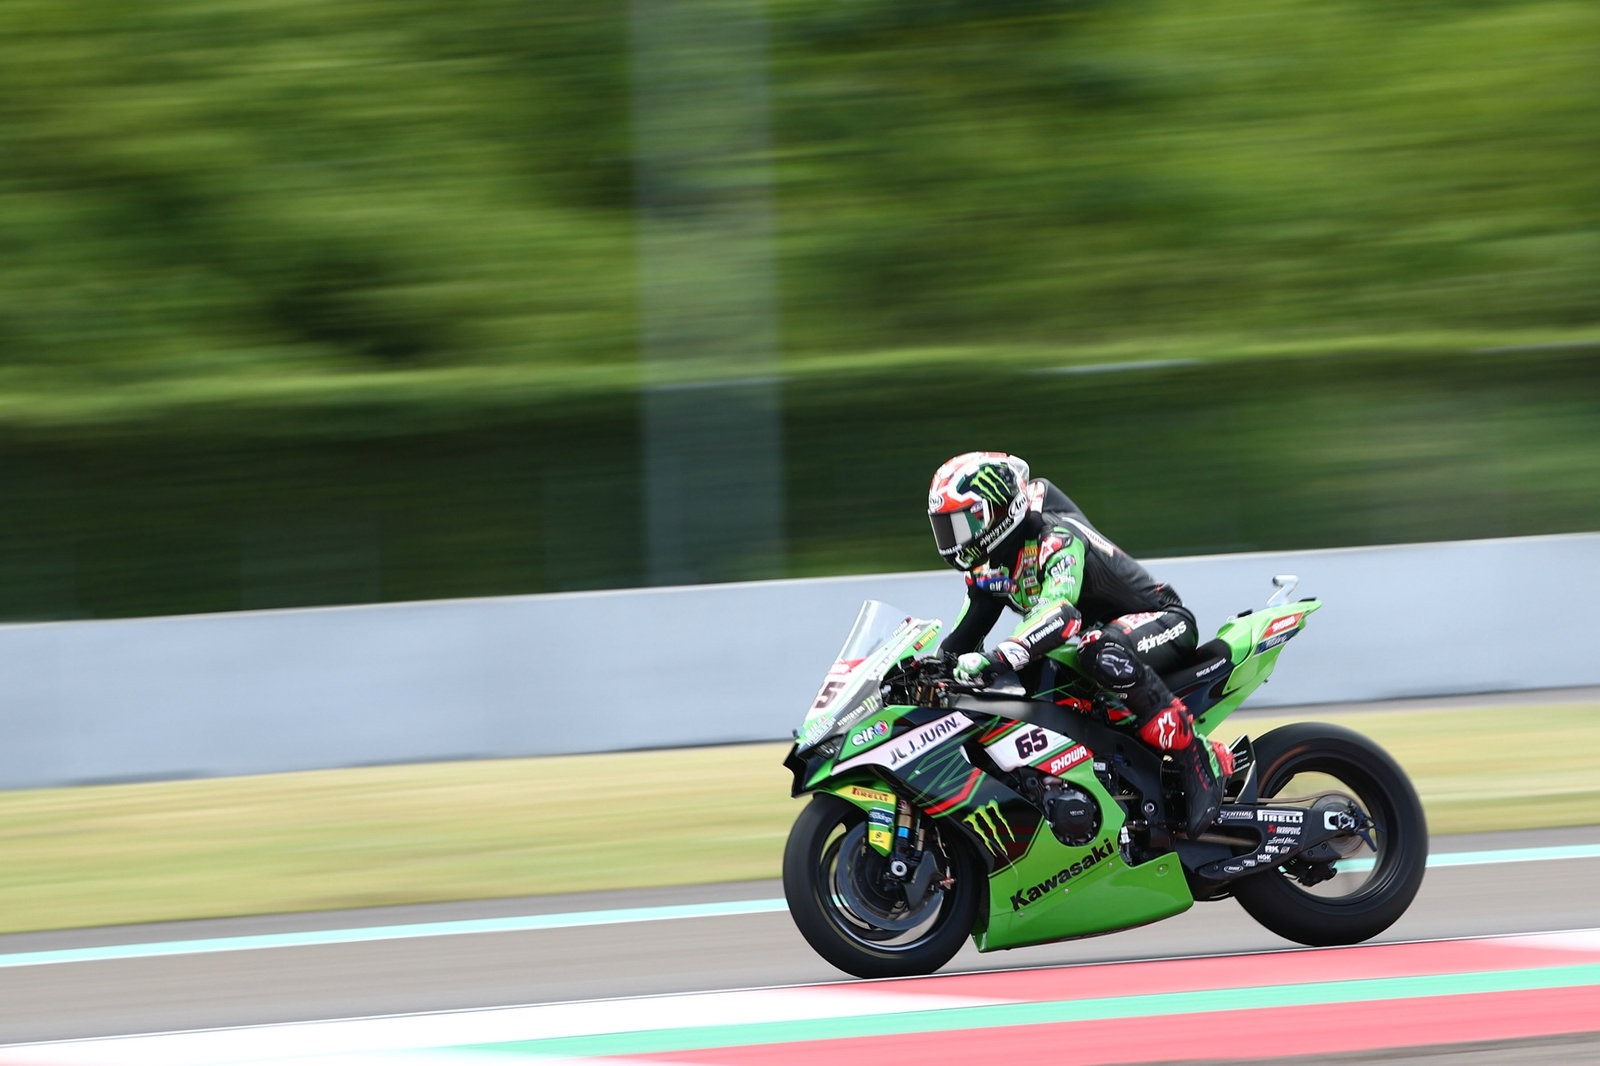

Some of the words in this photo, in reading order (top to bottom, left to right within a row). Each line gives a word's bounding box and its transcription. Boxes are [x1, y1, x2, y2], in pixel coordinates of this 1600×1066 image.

[1028, 616, 1065, 646] Kawasaki
[851, 724, 879, 746] elf
[1014, 728, 1049, 760] 65
[1050, 745, 1088, 775] SHOWA
[852, 787, 889, 802] PIRELLI
[1257, 809, 1304, 823] PIRELLI
[1265, 845, 1280, 853] RK
[1009, 838, 1115, 912] Kawasaki
